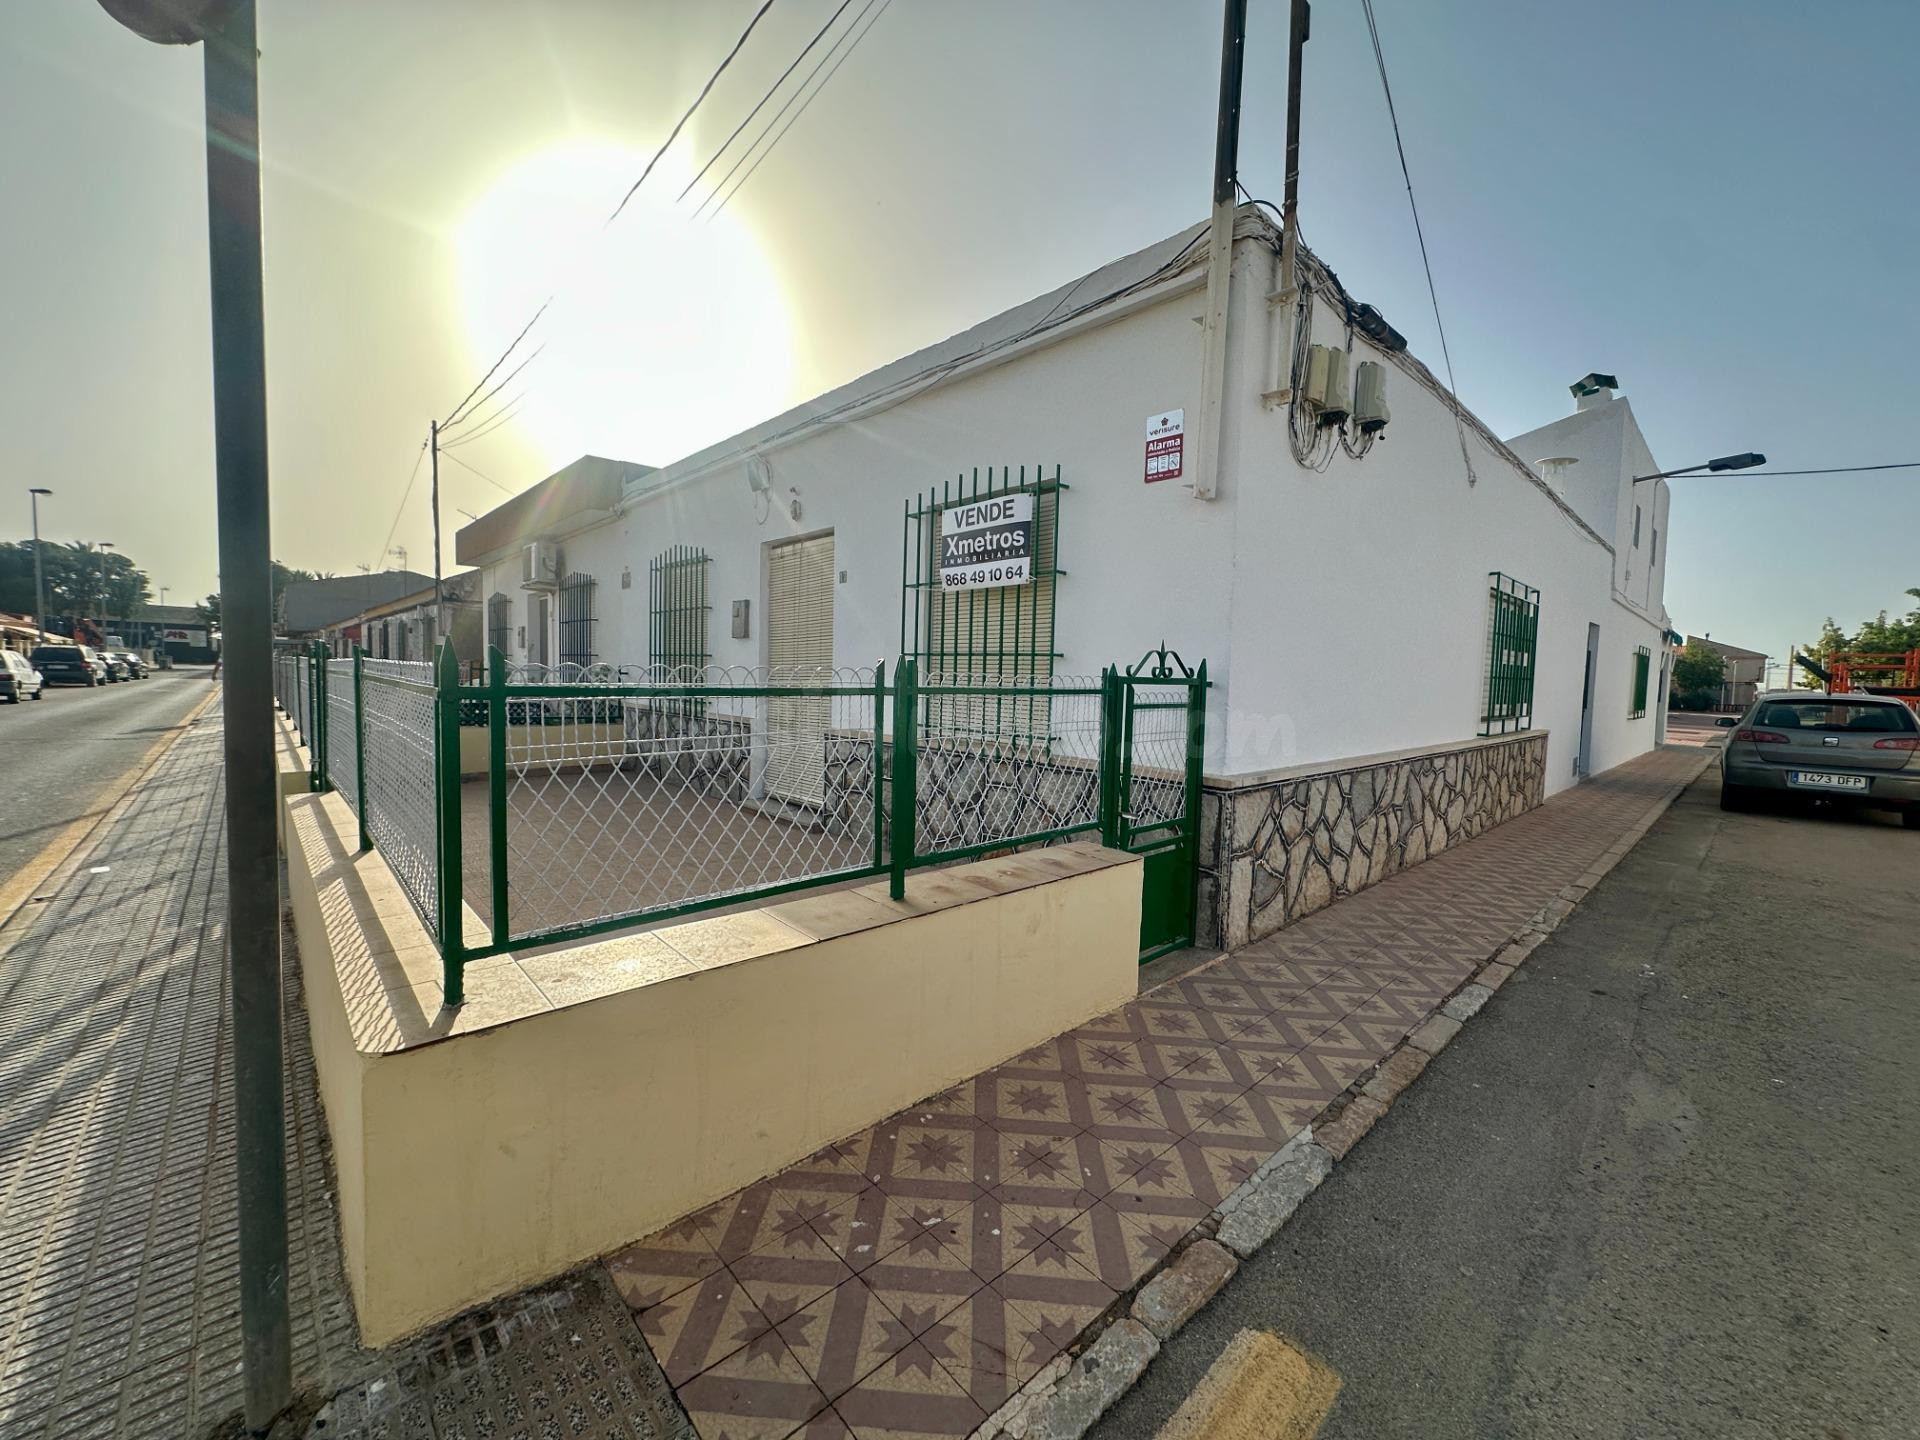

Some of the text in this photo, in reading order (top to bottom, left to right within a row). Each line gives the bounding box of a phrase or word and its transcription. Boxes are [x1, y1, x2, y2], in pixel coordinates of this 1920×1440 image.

[1149, 424, 1180, 436] verisure
[1148, 438, 1181, 452] Alarma
[954, 498, 1015, 529] VENDE
[946, 530, 1025, 557] Xmetros
[944, 548, 1025, 566] INMOBILIARIA
[945, 564, 1024, 587] 868 49 10 64
[1803, 773, 1832, 784] 1473
